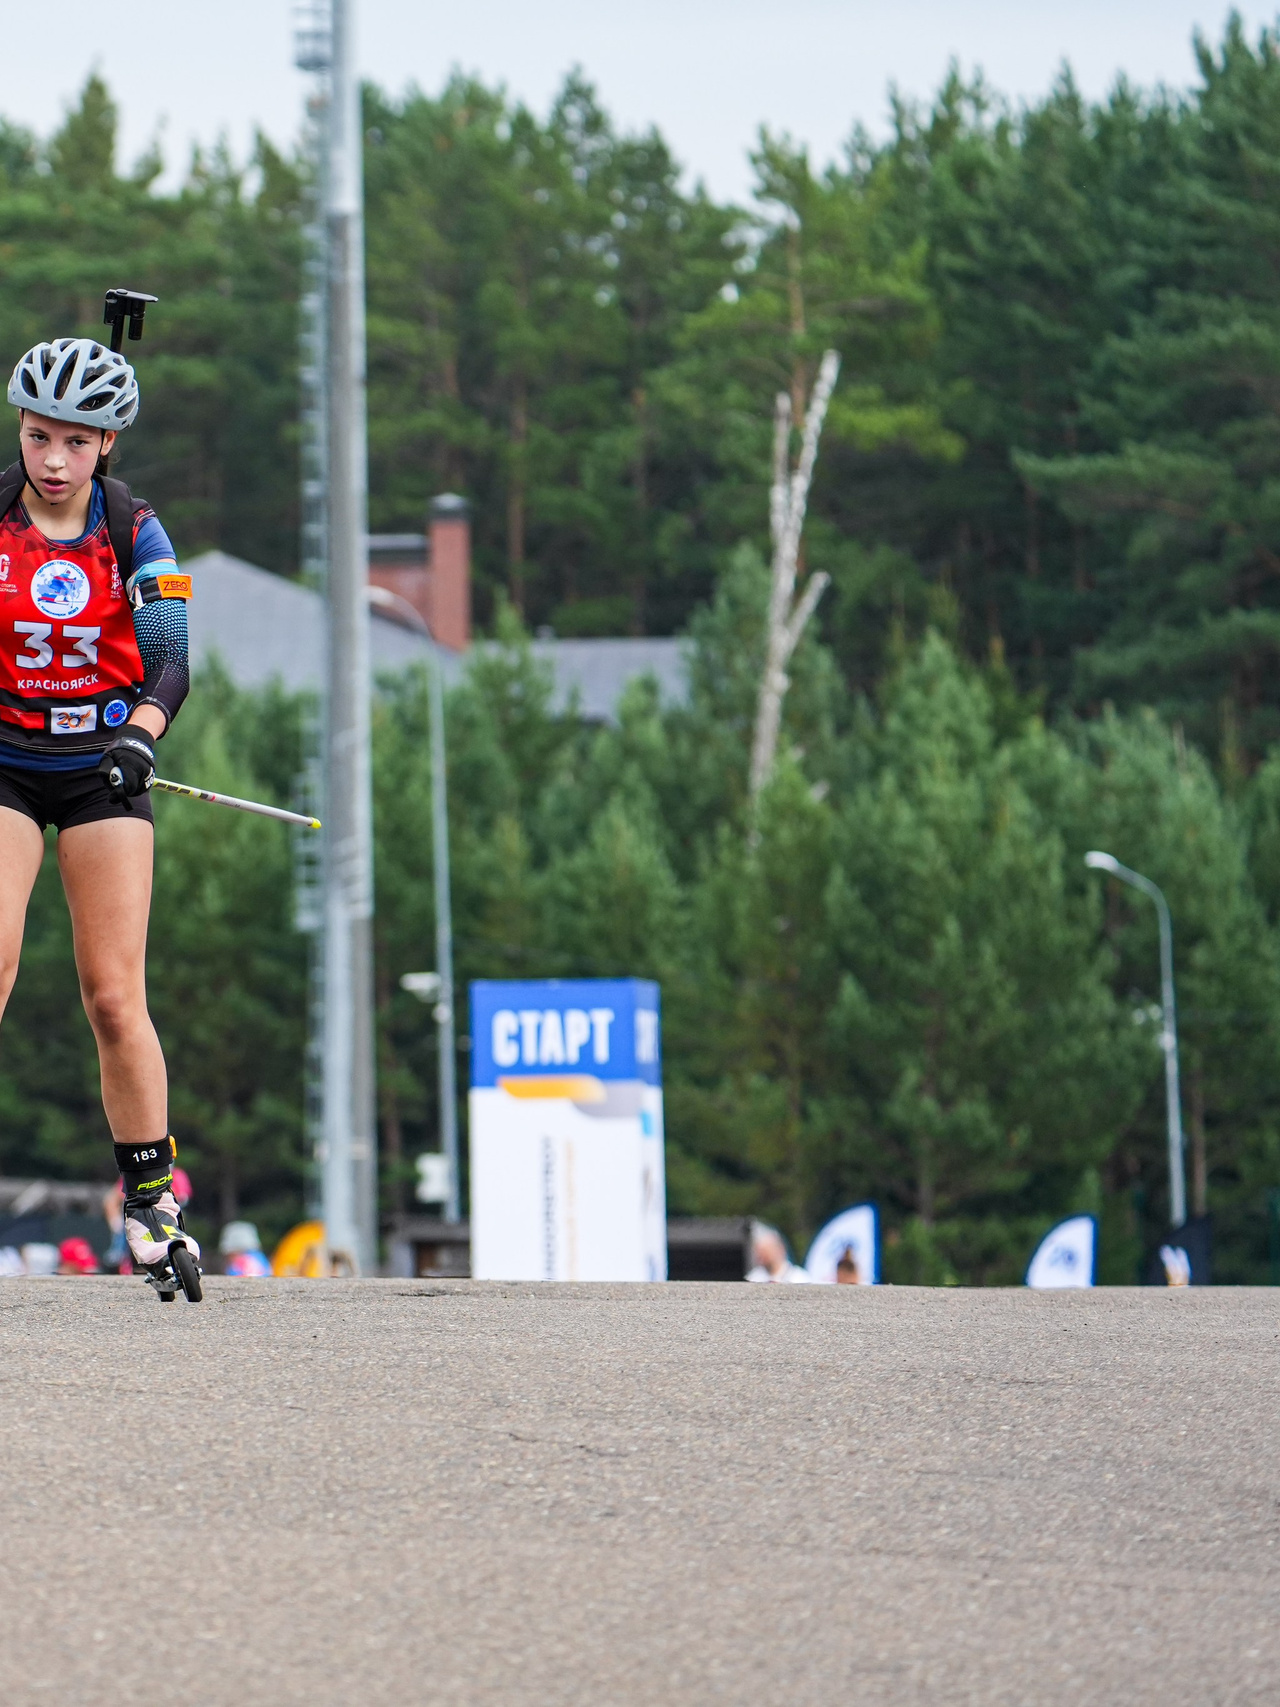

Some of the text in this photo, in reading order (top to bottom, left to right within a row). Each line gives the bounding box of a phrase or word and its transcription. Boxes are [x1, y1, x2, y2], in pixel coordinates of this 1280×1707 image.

[13, 620, 102, 669] 33
[17, 673, 99, 691] КРАСНОЯРСК
[491, 1007, 615, 1067] СТАРТ
[132, 1148, 158, 1163] 183
[136, 1172, 173, 1191] FISCH
